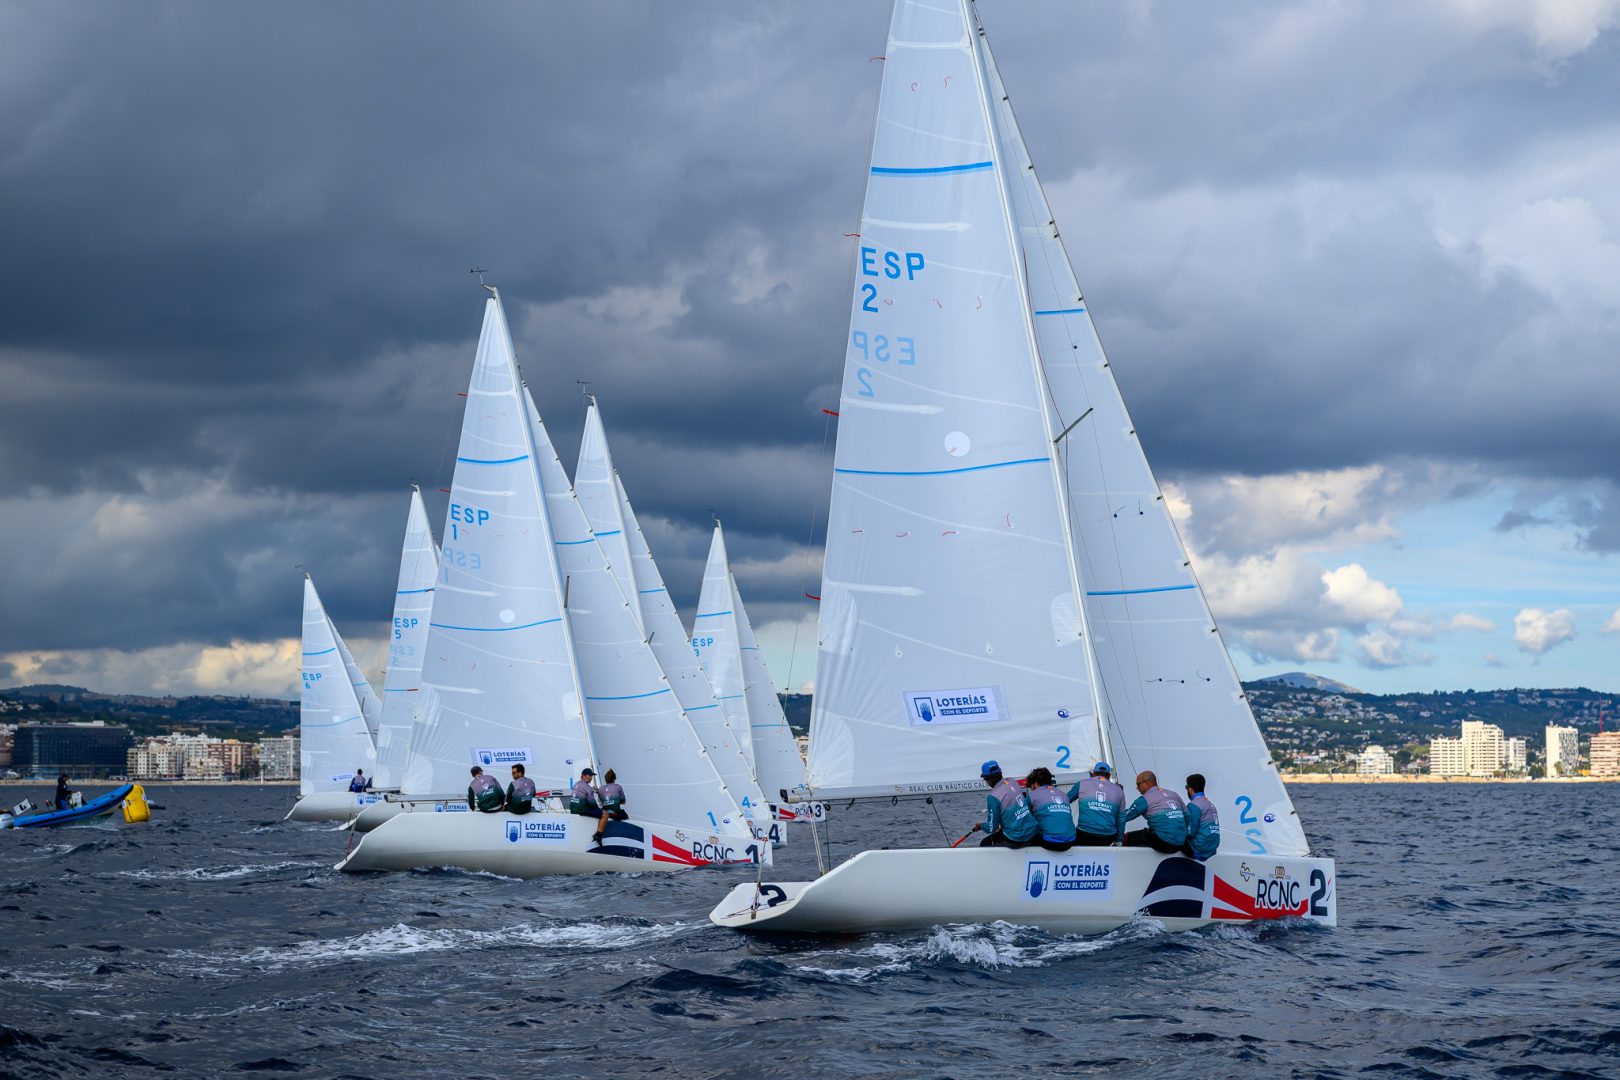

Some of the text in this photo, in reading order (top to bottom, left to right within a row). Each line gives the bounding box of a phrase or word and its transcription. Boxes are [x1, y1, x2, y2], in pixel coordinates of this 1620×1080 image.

[861, 247, 925, 281] ESP
[861, 283, 878, 313] 2
[451, 503, 490, 526] ESP
[452, 523, 457, 540] 1
[394, 617, 418, 629] ESP
[394, 629, 402, 640] 5
[692, 638, 714, 647] ESP
[302, 672, 322, 681] ESP
[936, 694, 987, 707] LOTERÍAS
[1056, 745, 1071, 769] 2
[926, 784, 944, 792] CLUB
[945, 782, 973, 790] NÁUTICO
[742, 796, 750, 808] 4
[1235, 795, 1257, 825] 2
[707, 811, 717, 827] 1
[814, 804, 822, 818] 3
[525, 820, 566, 831] LOTERÍAS
[769, 823, 780, 843] 4
[692, 841, 735, 861] RCNC
[745, 844, 759, 864] 1
[1054, 861, 1110, 877] LOTERÍAS
[1080, 881, 1105, 889] DEPORTE
[1309, 868, 1328, 917] 2
[1256, 878, 1300, 909] RCNC
